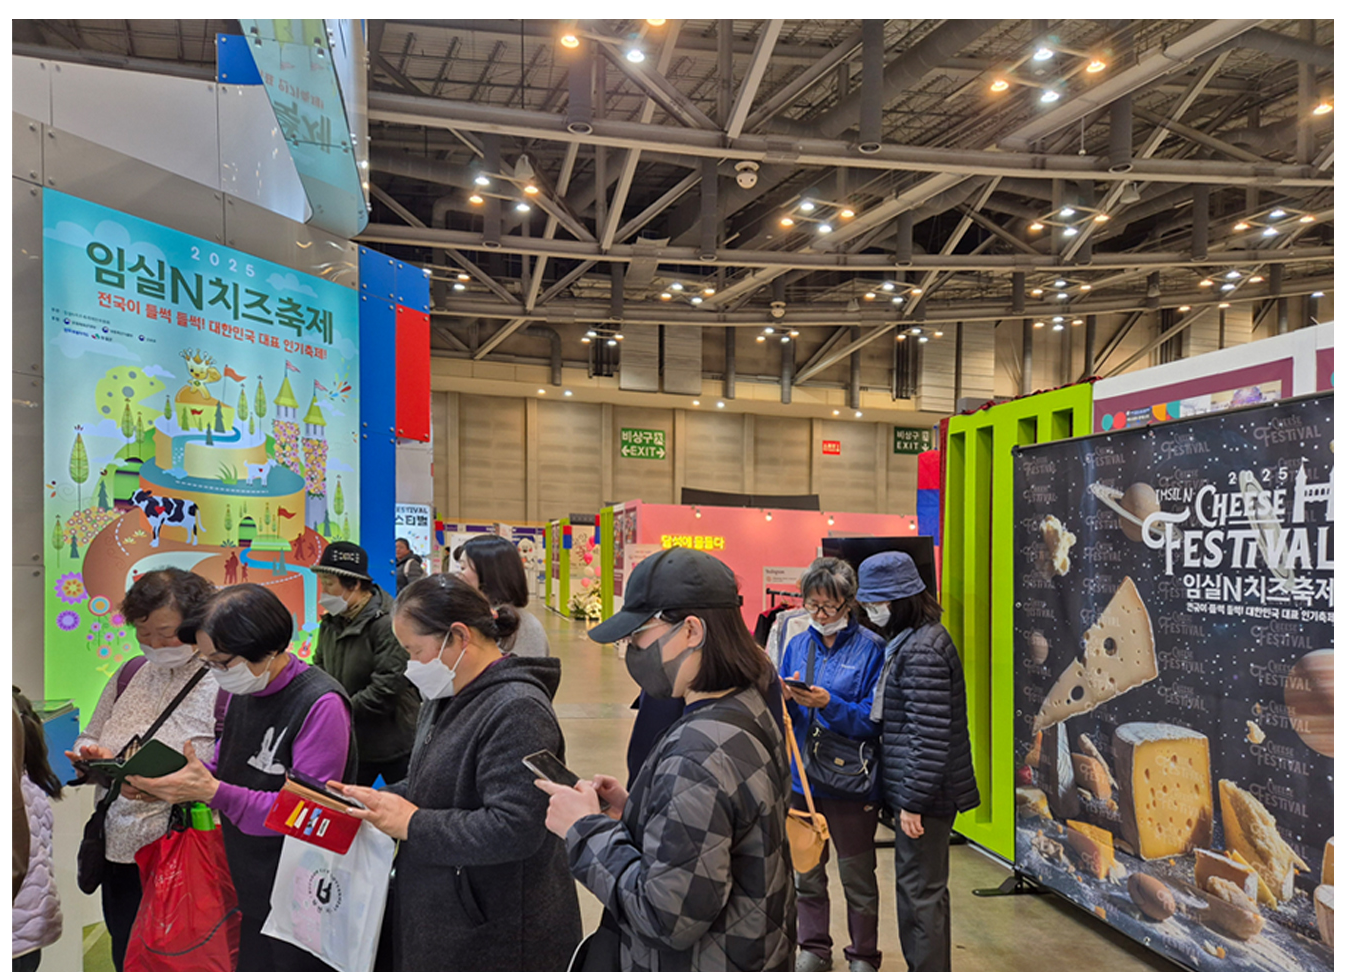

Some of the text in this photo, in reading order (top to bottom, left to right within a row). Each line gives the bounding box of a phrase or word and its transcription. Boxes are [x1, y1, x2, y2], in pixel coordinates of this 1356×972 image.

[191, 247, 256, 278] 2025
[87, 241, 333, 344] 임실N치즈축제
[98, 292, 327, 360] 전국이 들썩 들썩! 대한민국 대표 인기축제!
[622, 431, 653, 444] 비상구
[896, 441, 919, 450] EXIT
[897, 431, 919, 440] 비상구
[1253, 425, 1321, 447] FESTIVAL
[630, 446, 657, 456] EXIT
[1228, 467, 1288, 485] 2025
[1195, 485, 1287, 528] CHEESE
[1142, 506, 1334, 575] FESTIVAL
[1245, 605, 1279, 619] 대한민국
[1250, 625, 1313, 648] FESTIVAL
[1250, 665, 1311, 691] FESTIVAL
[1251, 704, 1311, 733] FESTIVAL
